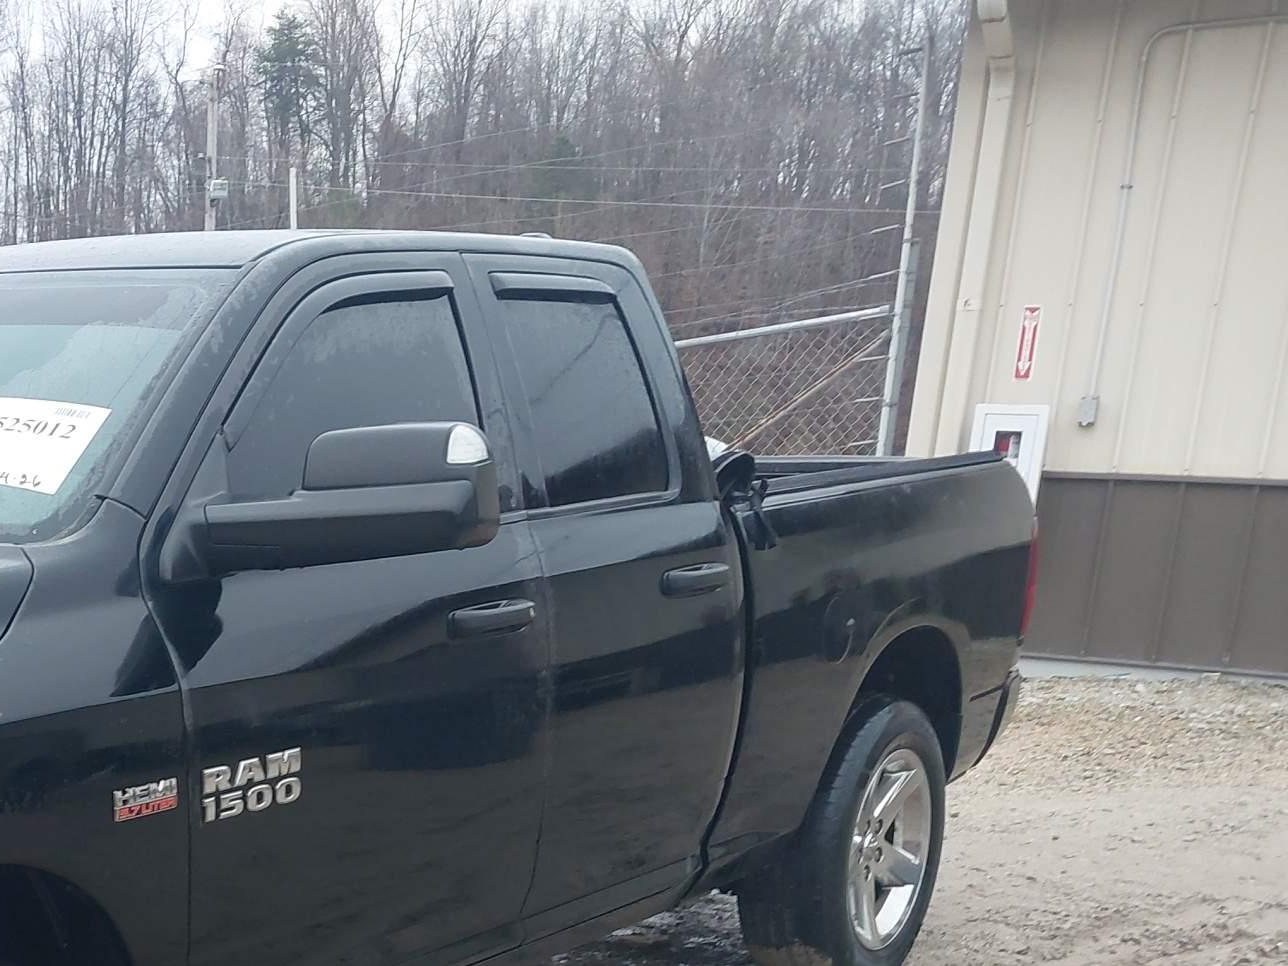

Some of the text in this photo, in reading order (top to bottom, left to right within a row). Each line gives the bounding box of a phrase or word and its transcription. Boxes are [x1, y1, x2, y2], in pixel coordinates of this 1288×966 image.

[113, 776, 178, 808] HEMI
[201, 747, 302, 795] RAM
[201, 776, 302, 823] 1500
